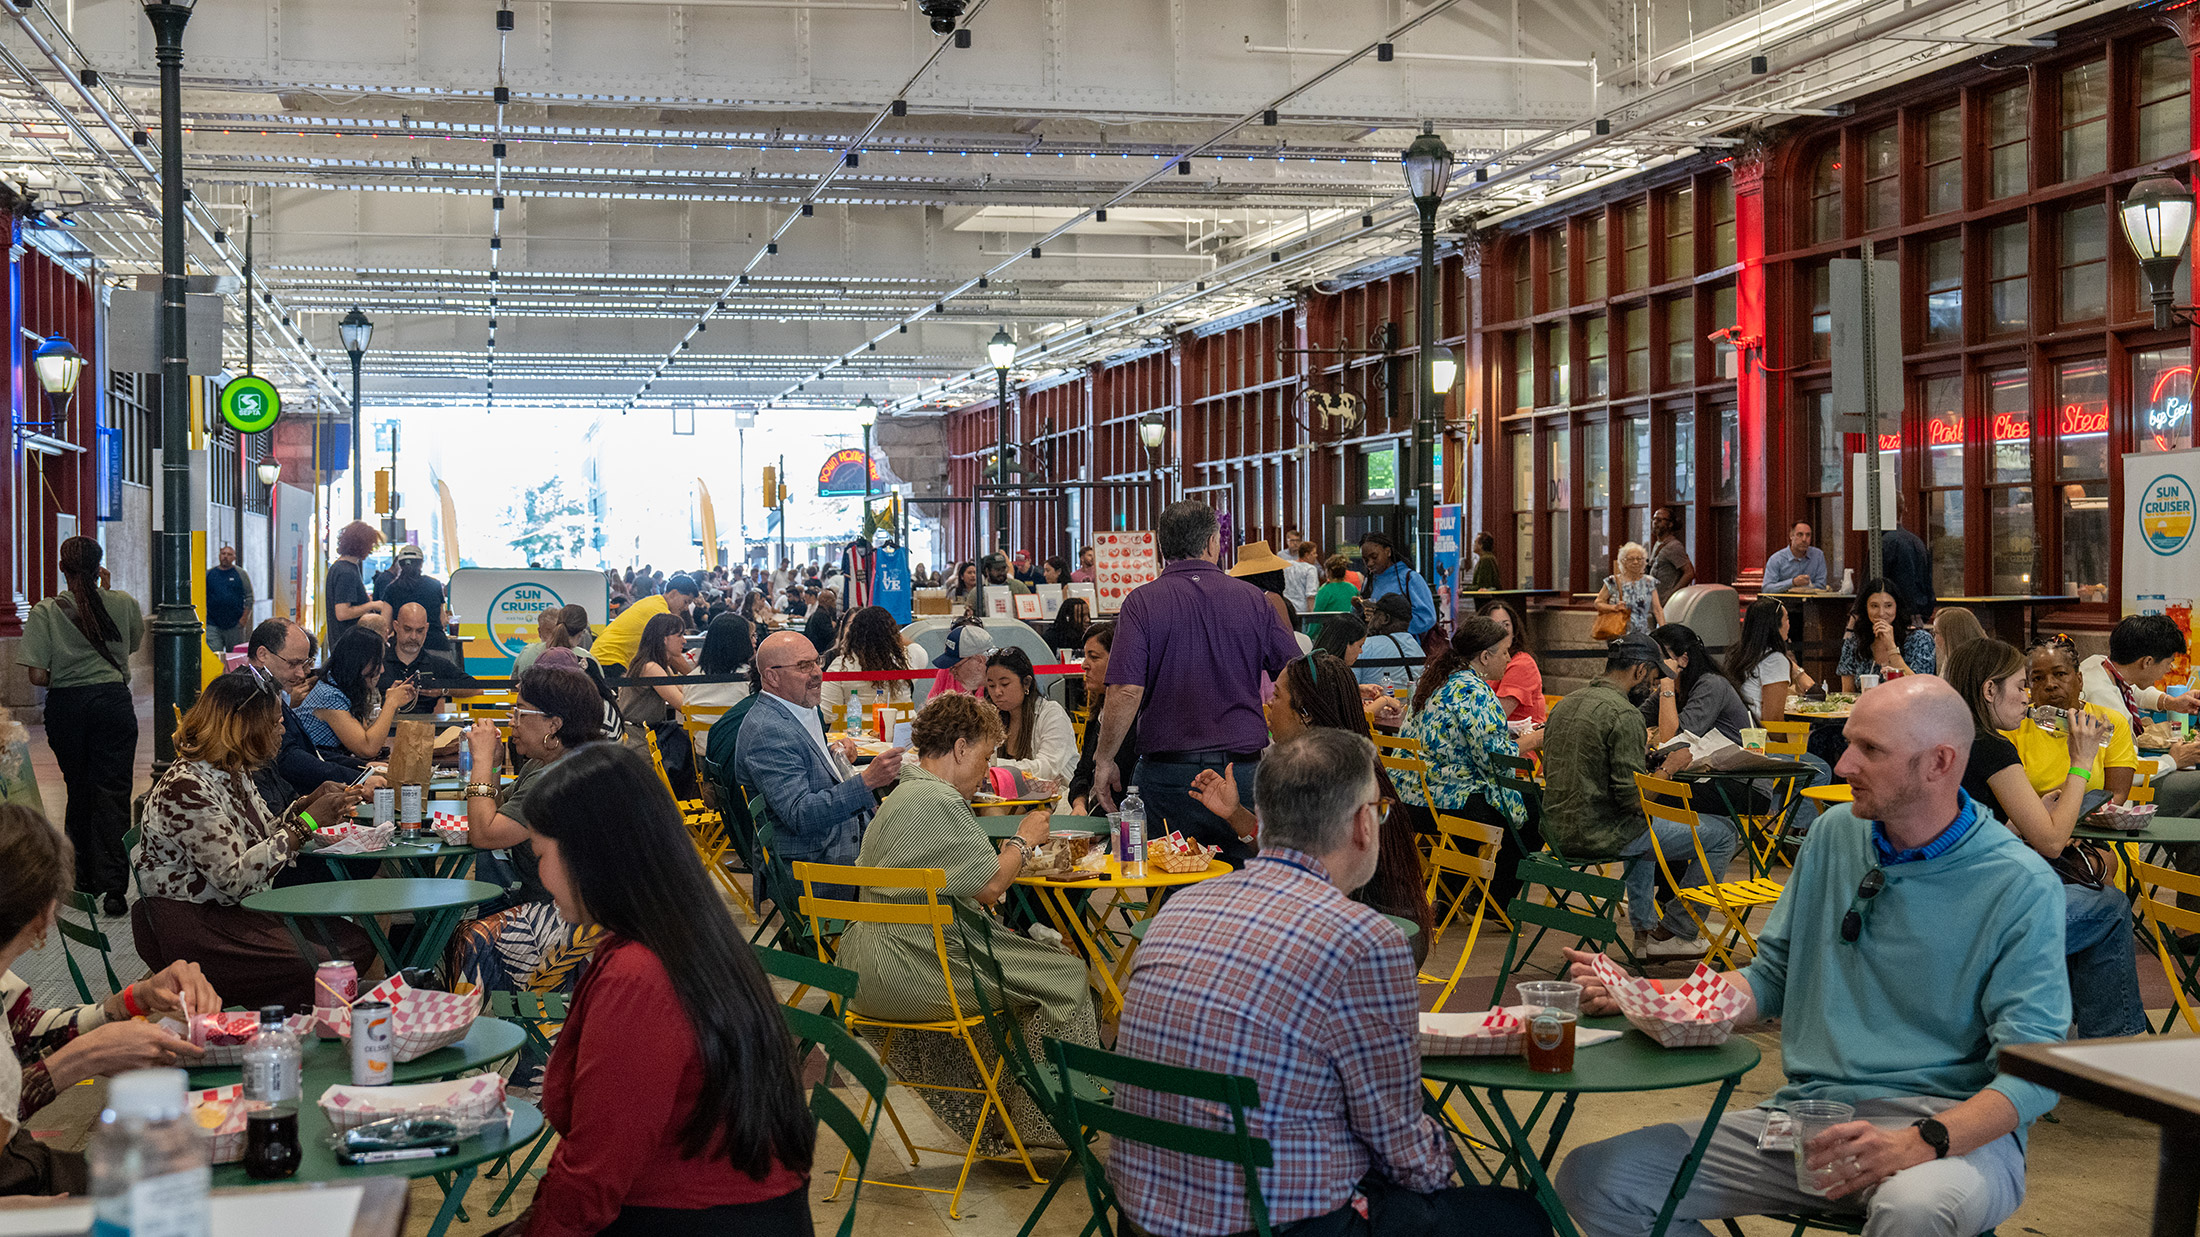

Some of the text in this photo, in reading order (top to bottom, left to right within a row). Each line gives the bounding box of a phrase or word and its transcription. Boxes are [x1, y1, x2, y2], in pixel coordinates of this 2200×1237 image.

[1994, 414, 2030, 440] Chee
[820, 456, 839, 482] DOWN
[838, 450, 866, 463] HOME
[2156, 486, 2179, 498] SUN
[2145, 501, 2190, 513] CRUISER
[1434, 517, 1456, 530] TRULY
[515, 590, 541, 600] SUN
